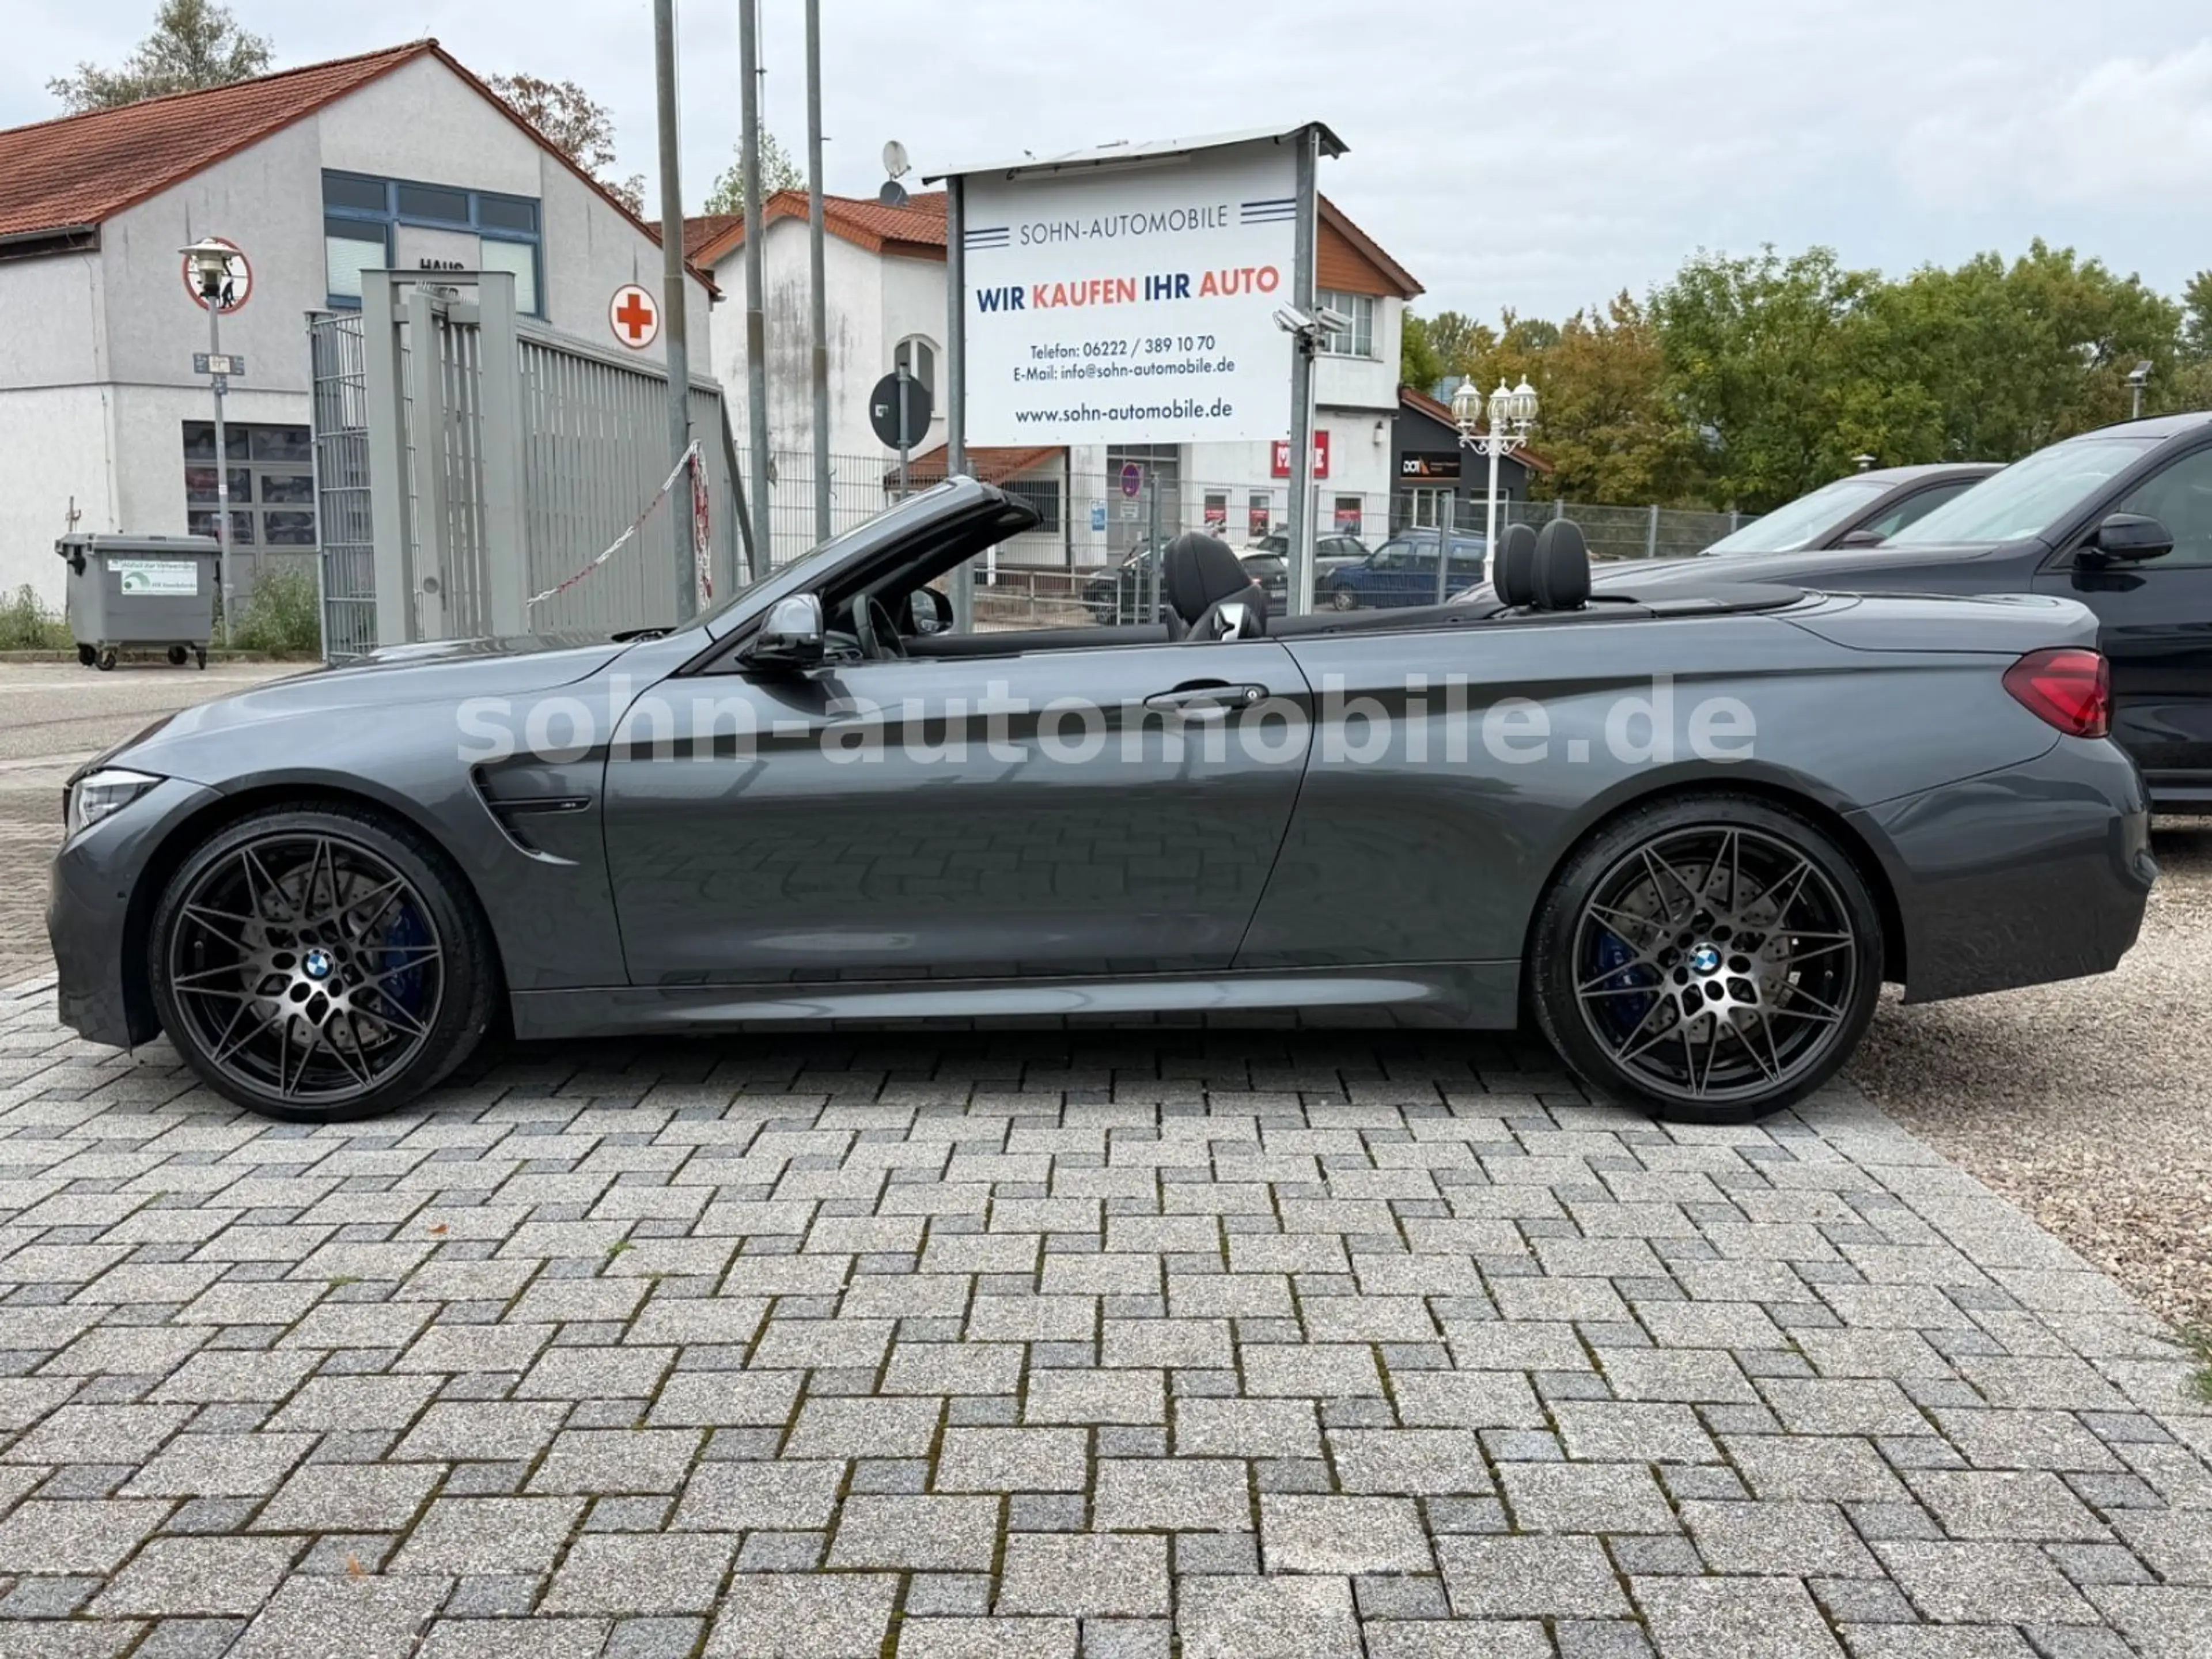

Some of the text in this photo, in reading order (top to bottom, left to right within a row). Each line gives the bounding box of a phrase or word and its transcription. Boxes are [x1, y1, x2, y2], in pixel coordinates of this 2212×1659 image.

[1020, 205, 1228, 245] SOHN-AUTOMOBILE
[977, 266, 1279, 312] WIR KAUFEN IHR AUTO
[1031, 335, 1215, 359] Telefon: 06222 / 389 10 70
[1014, 355, 1236, 381] E-Mail: info@sohn-automobile.de
[1016, 397, 1233, 423] www.sohn-automobile.de
